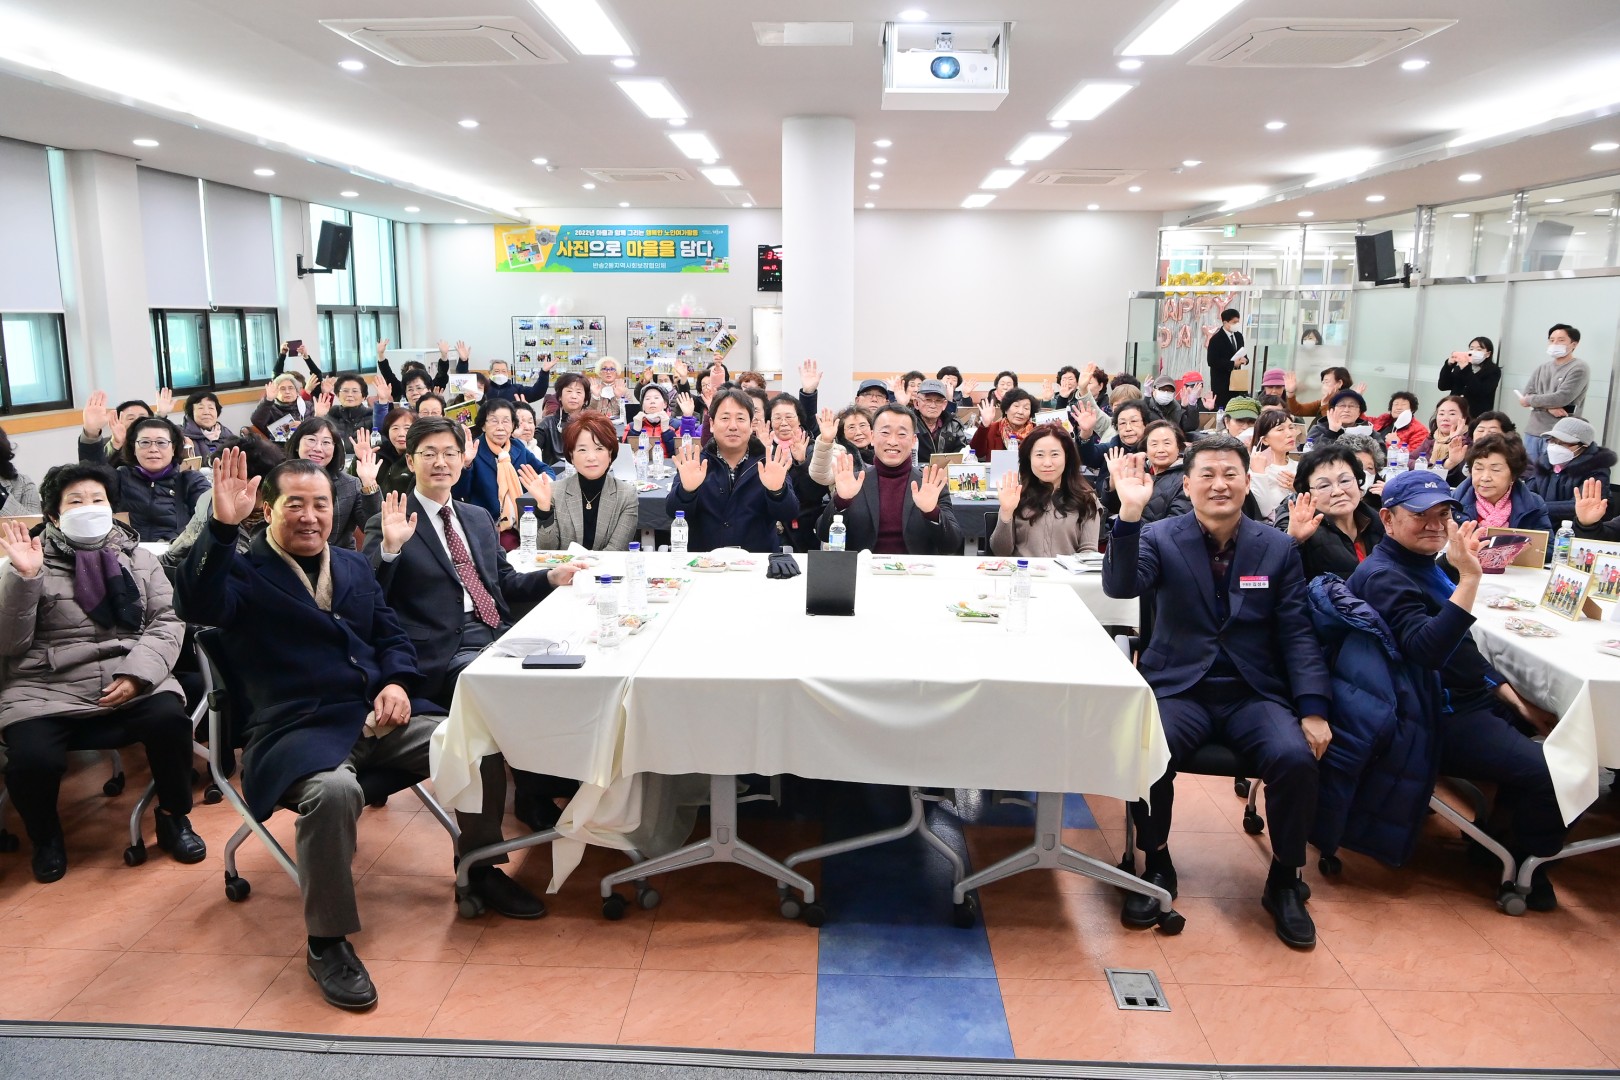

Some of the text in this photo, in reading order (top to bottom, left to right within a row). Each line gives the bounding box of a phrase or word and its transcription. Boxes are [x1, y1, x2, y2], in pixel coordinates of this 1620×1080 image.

[574, 229, 595, 237] 2022년
[556, 240, 714, 258] 사진으로 마을을 담다
[1158, 290, 1237, 323] APPY
